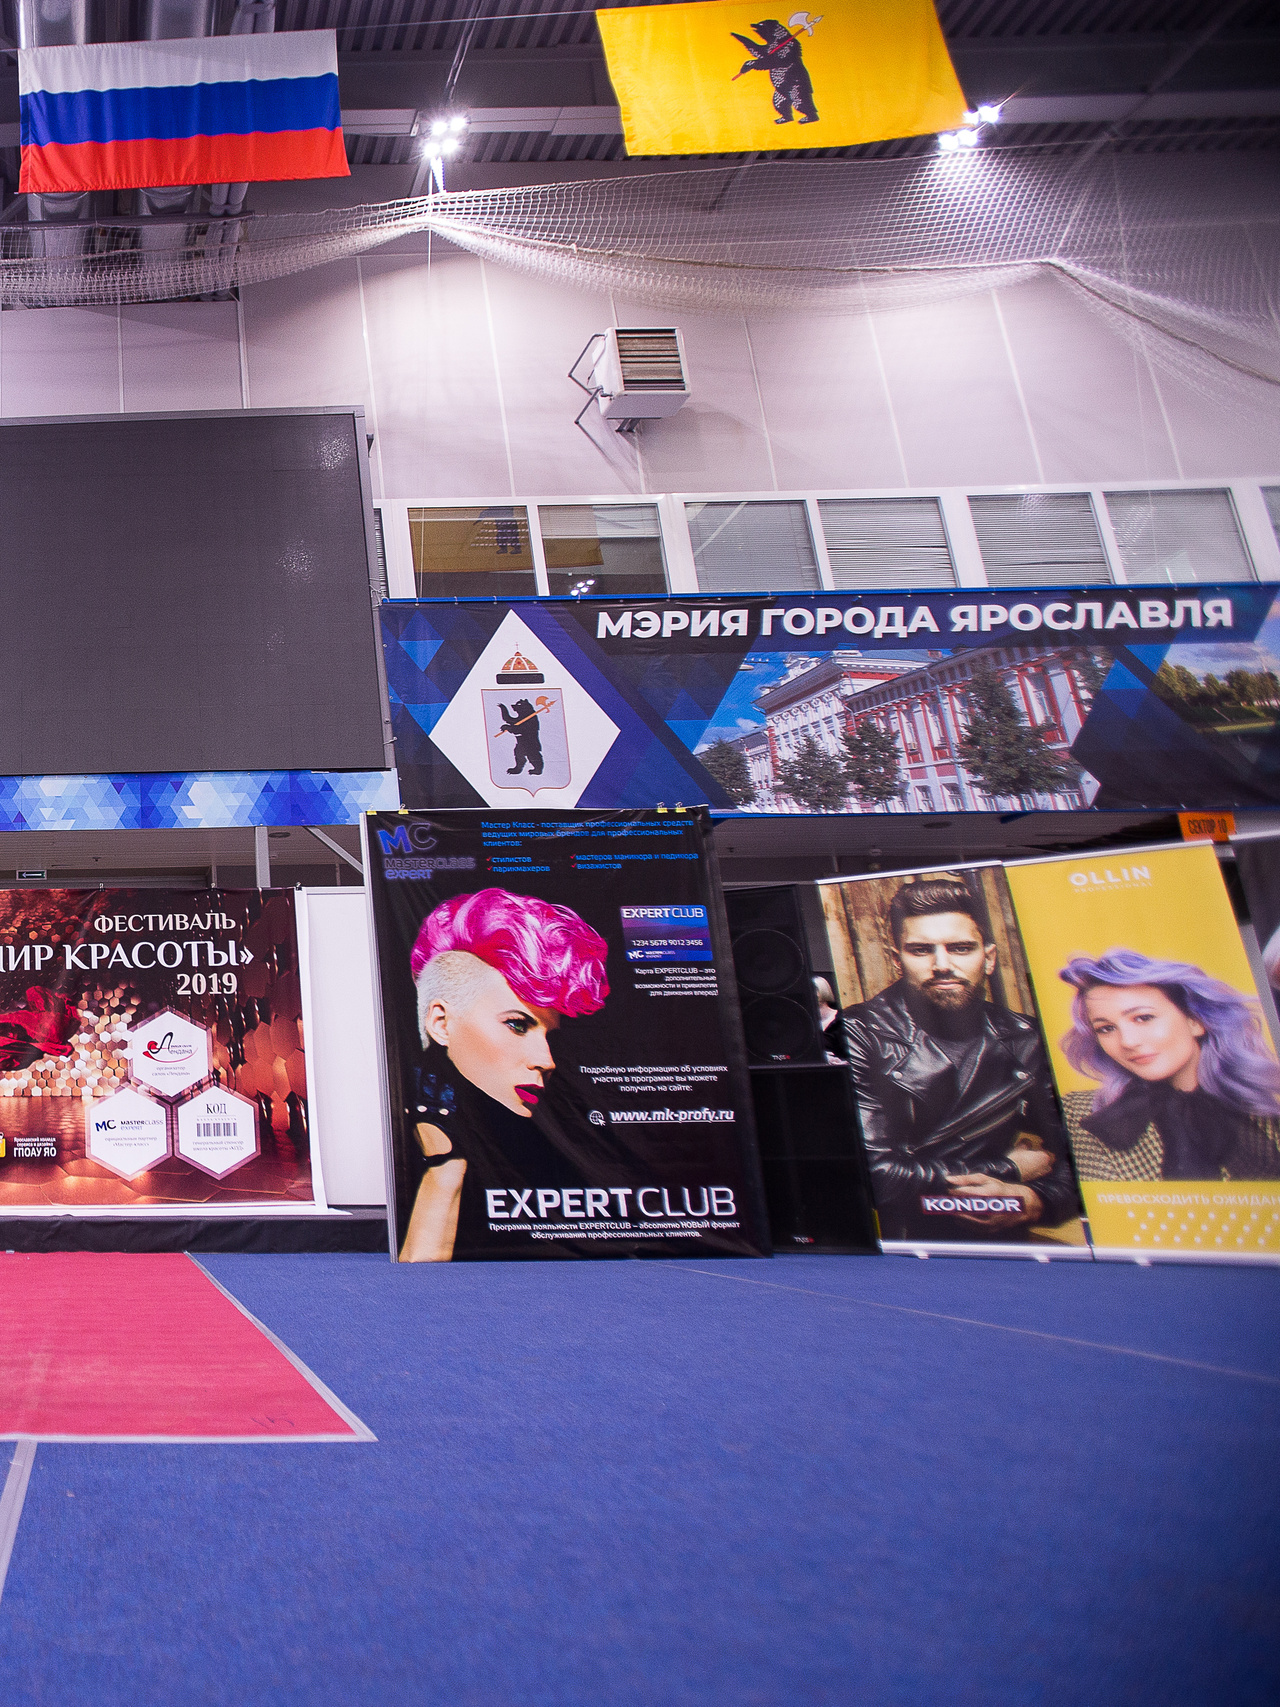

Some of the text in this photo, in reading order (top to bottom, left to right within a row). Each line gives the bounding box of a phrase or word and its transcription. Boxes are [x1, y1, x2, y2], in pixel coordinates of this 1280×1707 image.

[597, 598, 1233, 640] МЭРИЯ ГОРОДА ЯРОСЛАВЛЯ
[585, 820, 661, 828] профессиональных
[1188, 818, 1227, 835] СЕКТОР 10
[556, 830, 589, 838] брендов
[607, 829, 683, 838] профессиональных
[576, 854, 613, 862] мастеров
[614, 853, 653, 861] маникюра
[661, 852, 699, 860] педикюра
[493, 865, 550, 873] парикмахеров
[1069, 866, 1151, 886] OLLIN
[94, 912, 236, 934] ФЕСТИВАЛЬ
[64, 940, 254, 972] КРАСОТЫ»
[177, 973, 238, 996] 2019
[580, 1066, 625, 1074] Подробную
[628, 1065, 679, 1074] информацию
[681, 1064, 691, 1072] об
[620, 1085, 656, 1093] получить
[610, 1108, 735, 1123] www.mk-profy.ru
[14, 1147, 56, 1157] ГПОАУ ЯО
[1097, 1194, 1210, 1205] ПРЕВОСХОДИТЬ
[924, 1197, 1023, 1215] KONDOR
[489, 1220, 740, 1231] Программа лояльности EXPERTCLUB абсолютно НОВЫЙ формат
[532, 1231, 586, 1240] обслуживания
[588, 1231, 664, 1239] профессиональных
